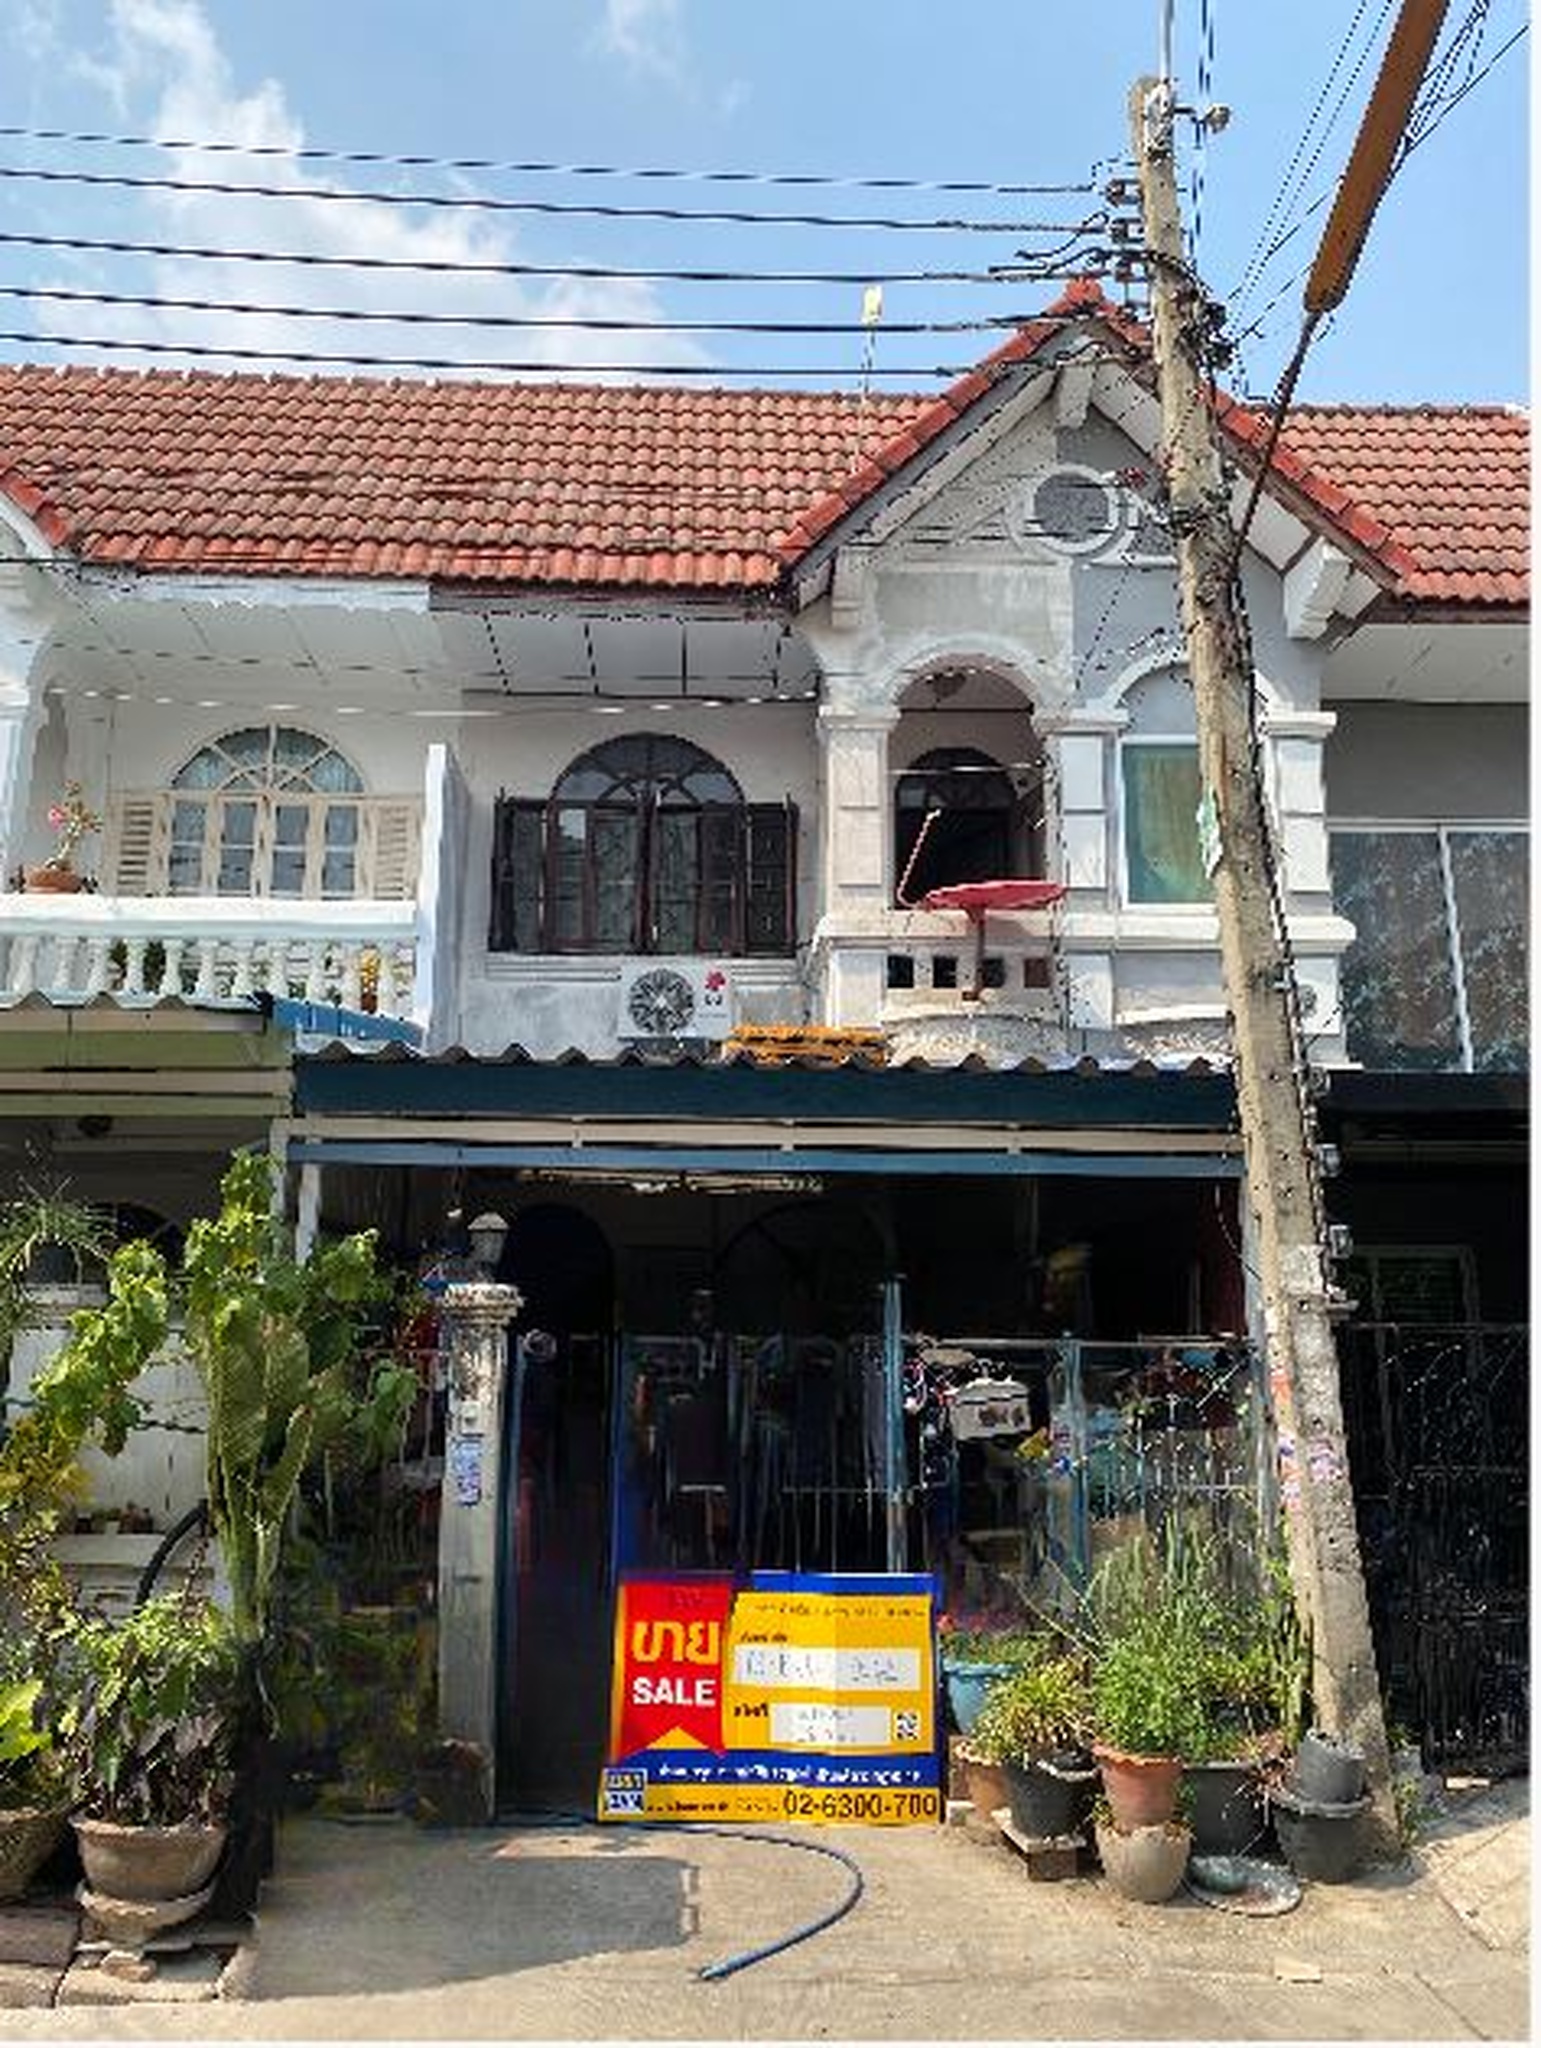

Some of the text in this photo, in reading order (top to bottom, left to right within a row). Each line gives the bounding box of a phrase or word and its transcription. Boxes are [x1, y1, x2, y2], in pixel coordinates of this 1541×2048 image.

[632, 1621, 720, 1665] ขาย
[632, 1676, 716, 1707] SALE
[783, 1789, 938, 1818] 02-6300-700
